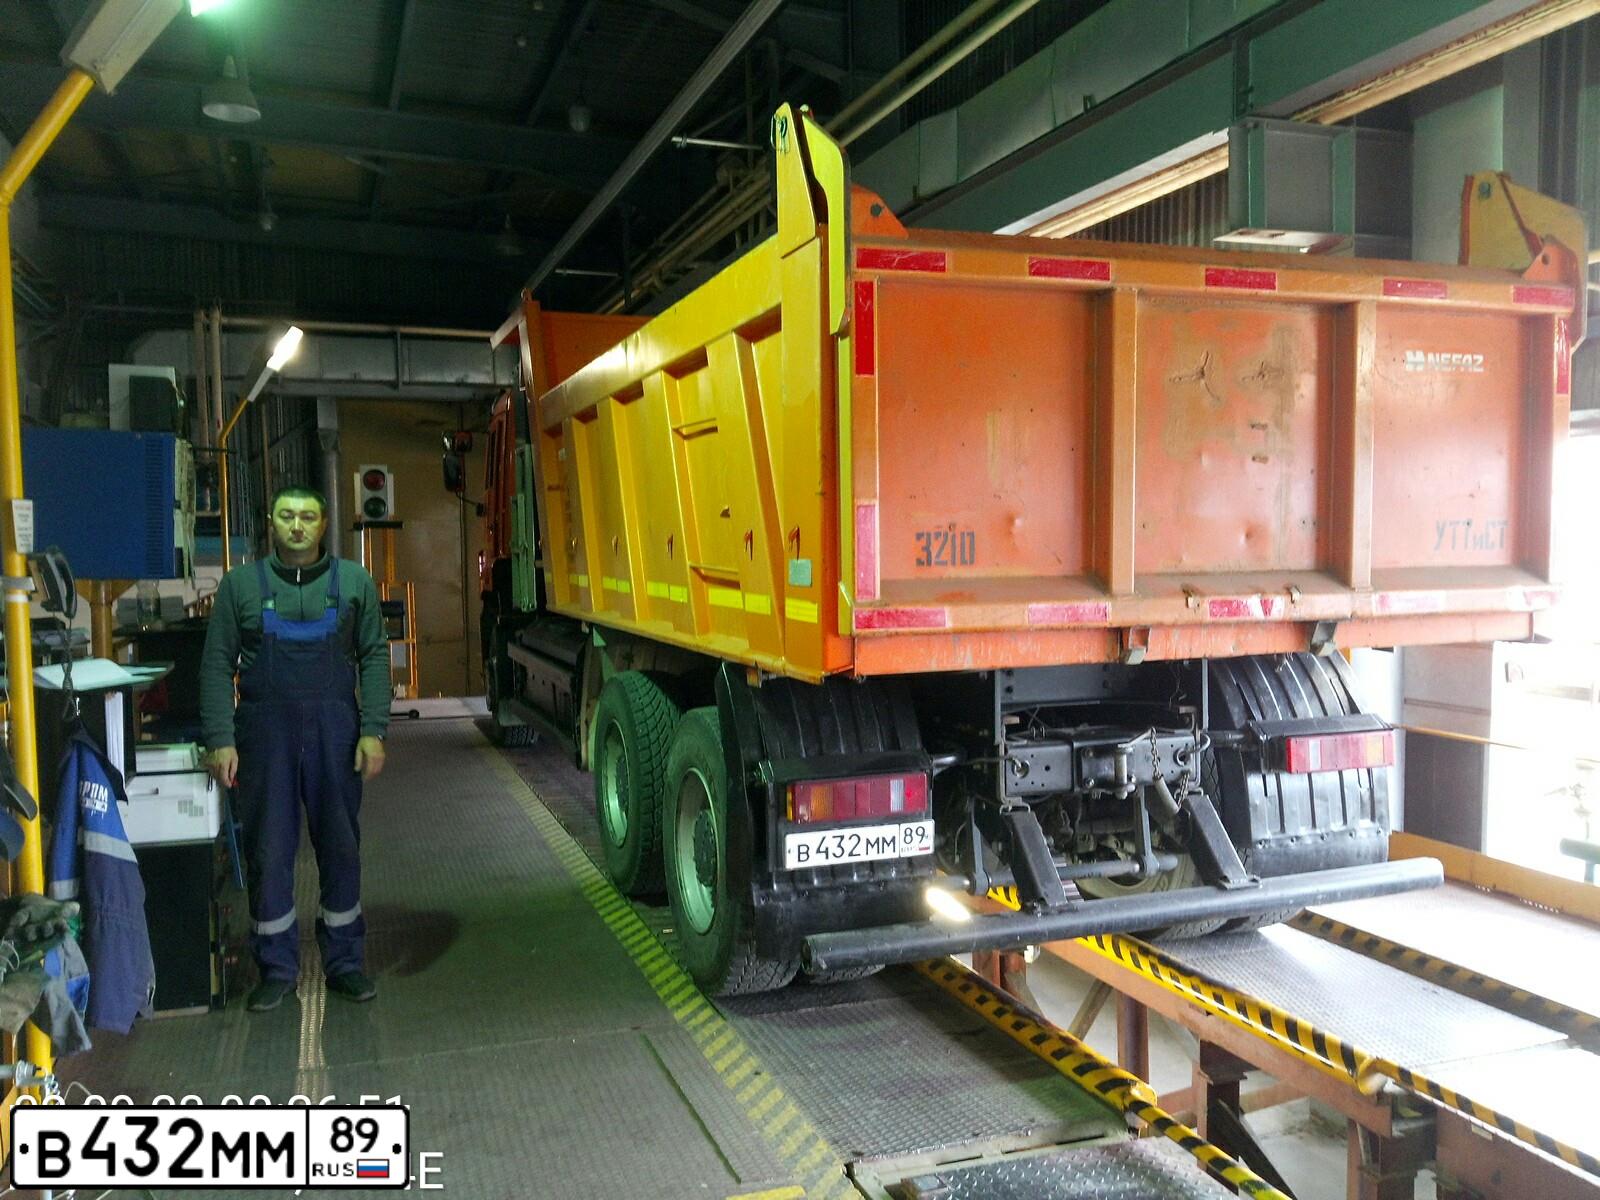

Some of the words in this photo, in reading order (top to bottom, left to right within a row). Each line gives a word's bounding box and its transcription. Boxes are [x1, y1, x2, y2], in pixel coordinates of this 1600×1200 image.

[1427, 352, 1484, 372] NEFAZ
[915, 531, 975, 567] 3210
[903, 826, 926, 845] 89
